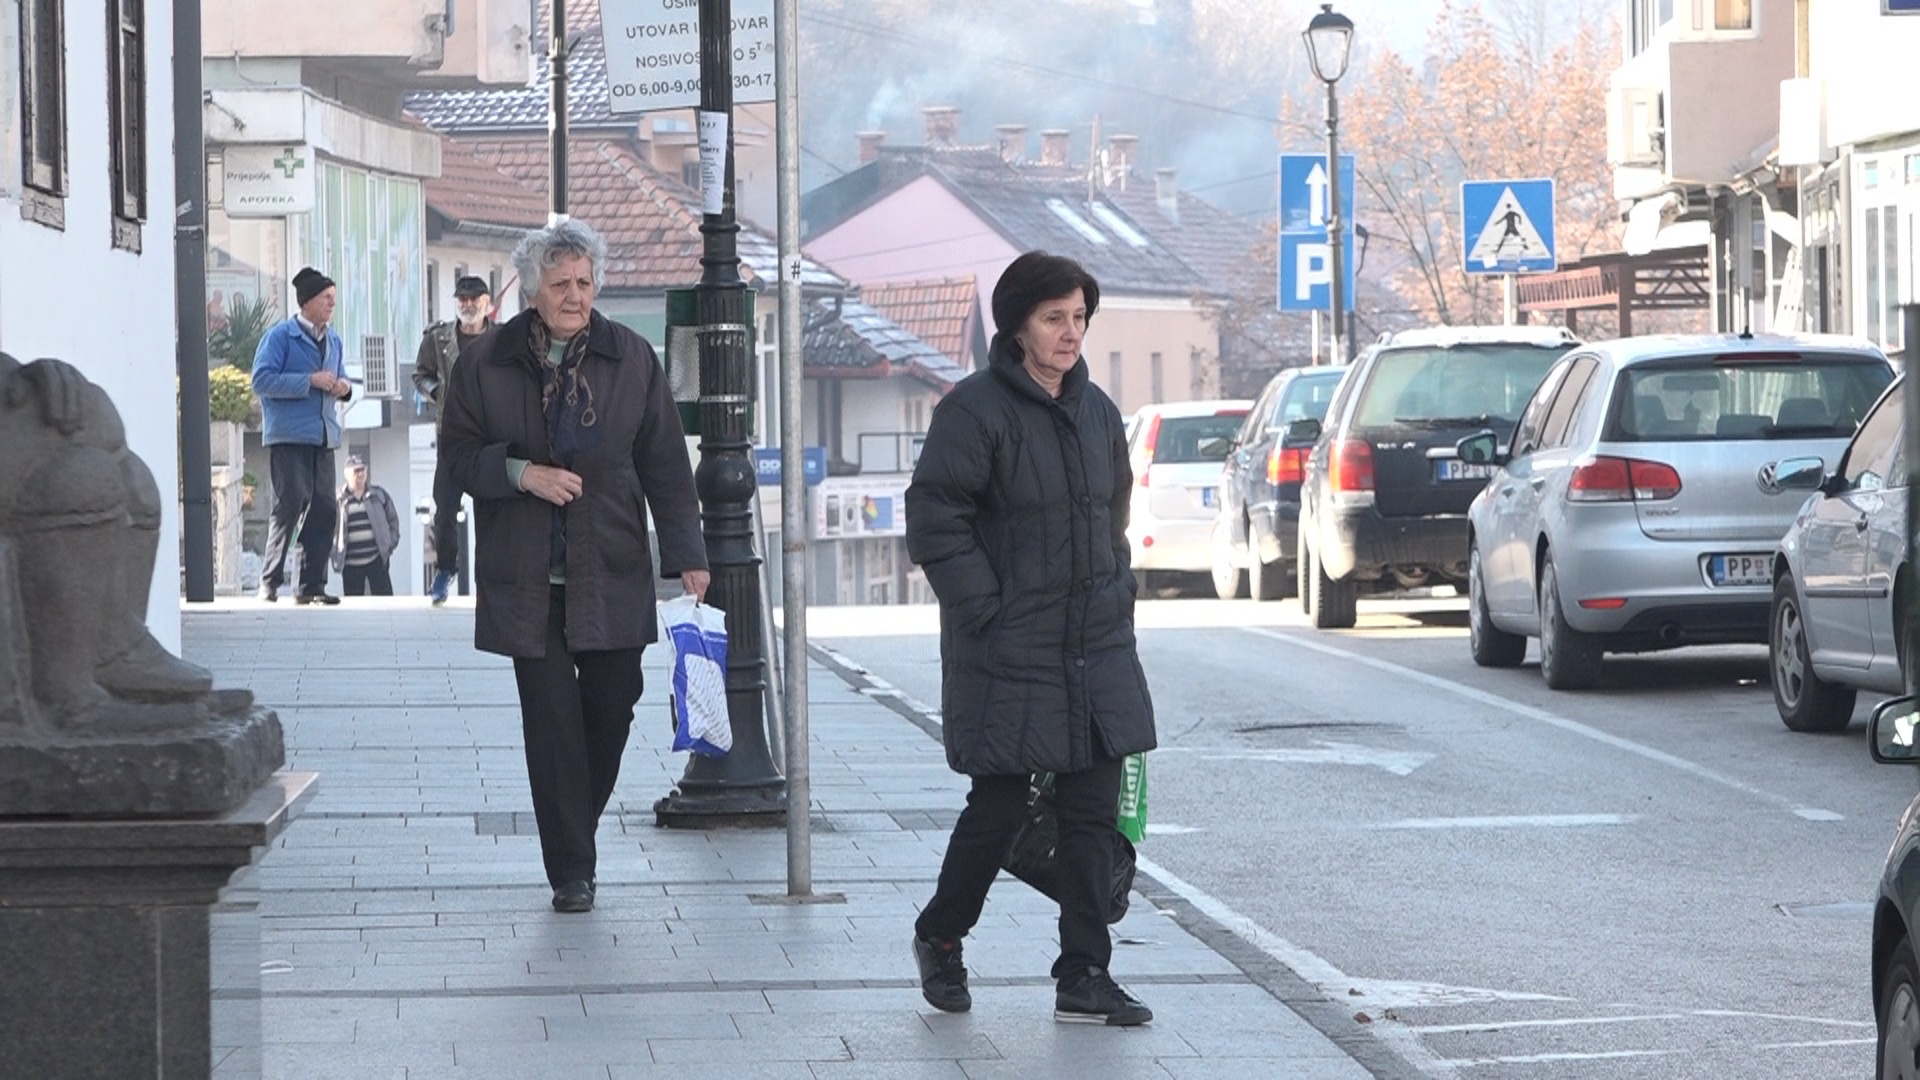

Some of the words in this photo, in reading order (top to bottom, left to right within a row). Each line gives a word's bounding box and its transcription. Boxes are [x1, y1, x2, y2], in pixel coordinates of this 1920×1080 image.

[626, 22, 689, 39] UTOVAR
[636, 51, 701, 69] NOSIVOS
[612, 83, 636, 98] OD
[239, 195, 295, 204] APOTEKA
[1296, 243, 1335, 301] P
